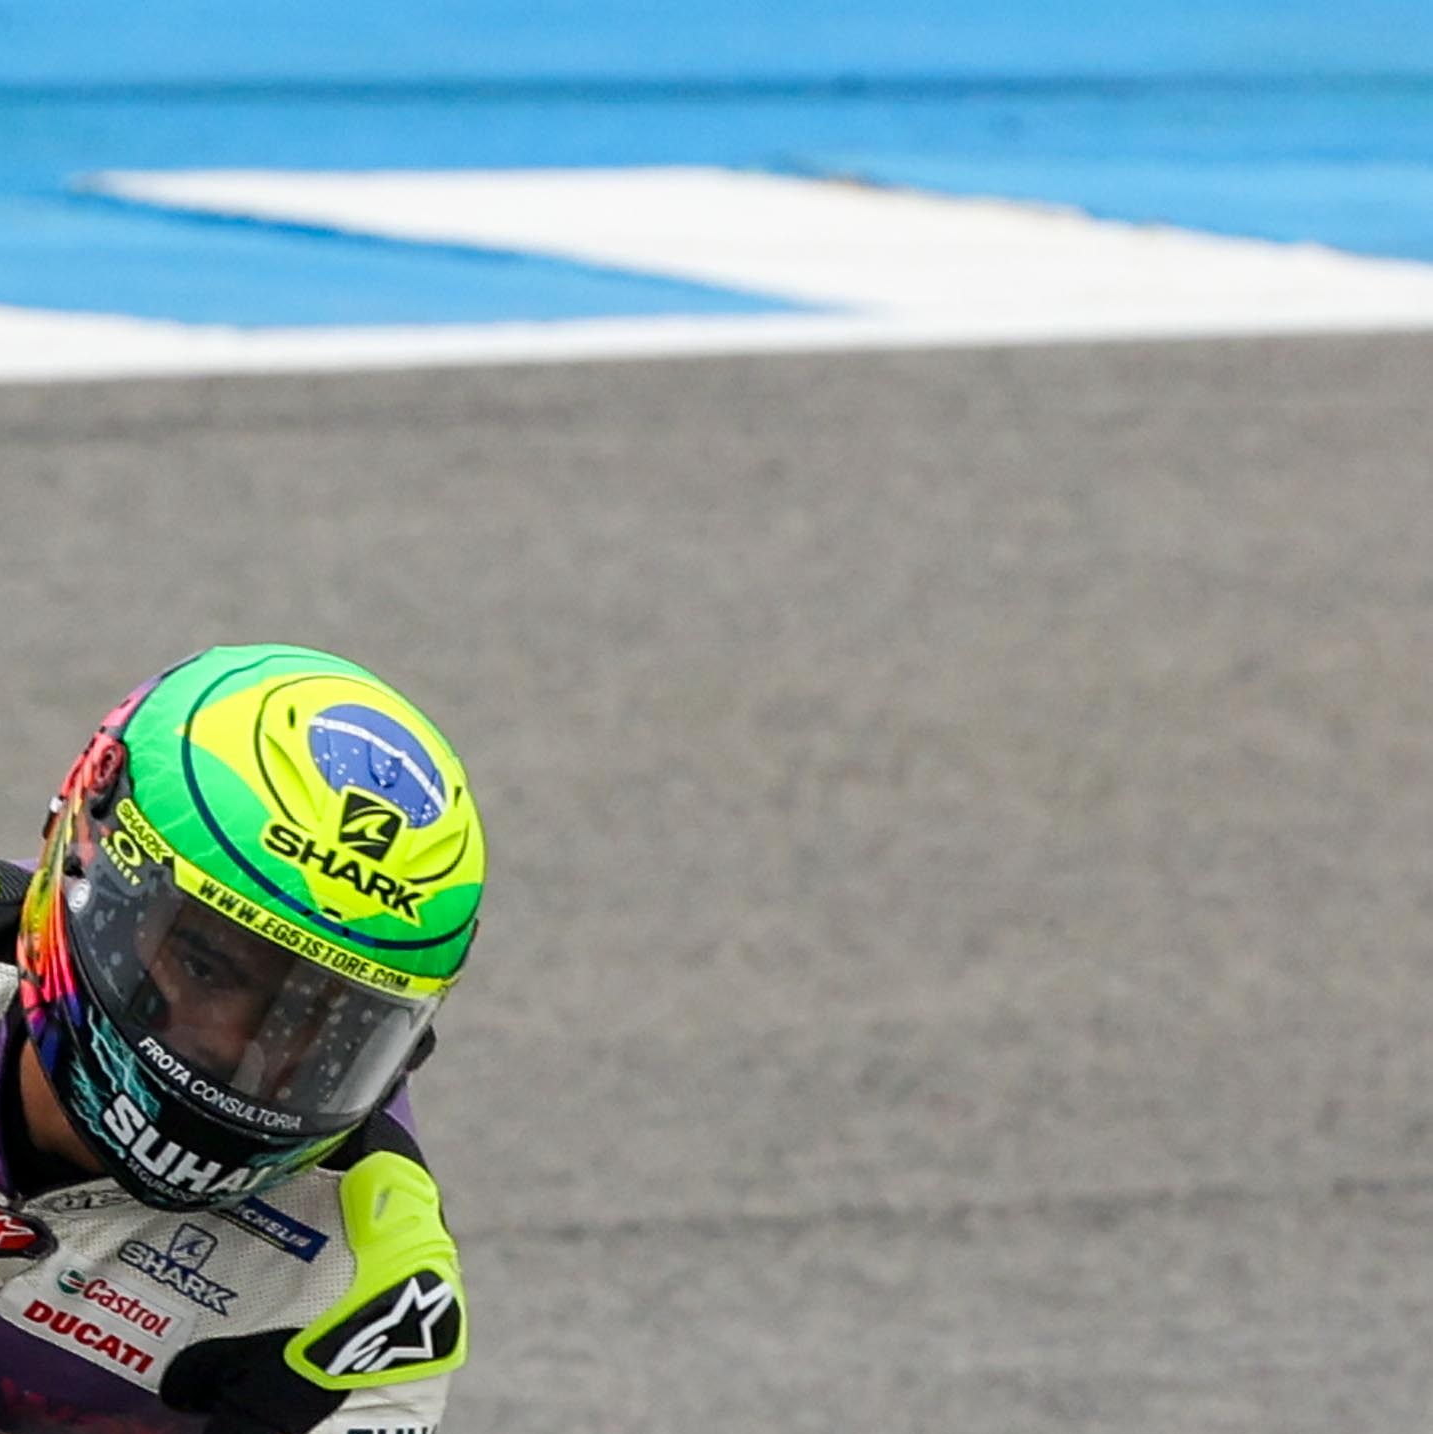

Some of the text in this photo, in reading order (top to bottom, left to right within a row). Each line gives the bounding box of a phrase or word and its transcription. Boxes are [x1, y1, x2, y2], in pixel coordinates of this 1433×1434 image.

[118, 802, 170, 863] SHARK
[265, 823, 424, 921] SHARK
[197, 878, 411, 991] WWW.EG51STORE.COM
[138, 1035, 303, 1131] FROTA CONSULTORIA
[82, 1275, 173, 1340] Castrol
[117, 1239, 238, 1316] SHARK
[22, 1300, 155, 1376] DUCATI
